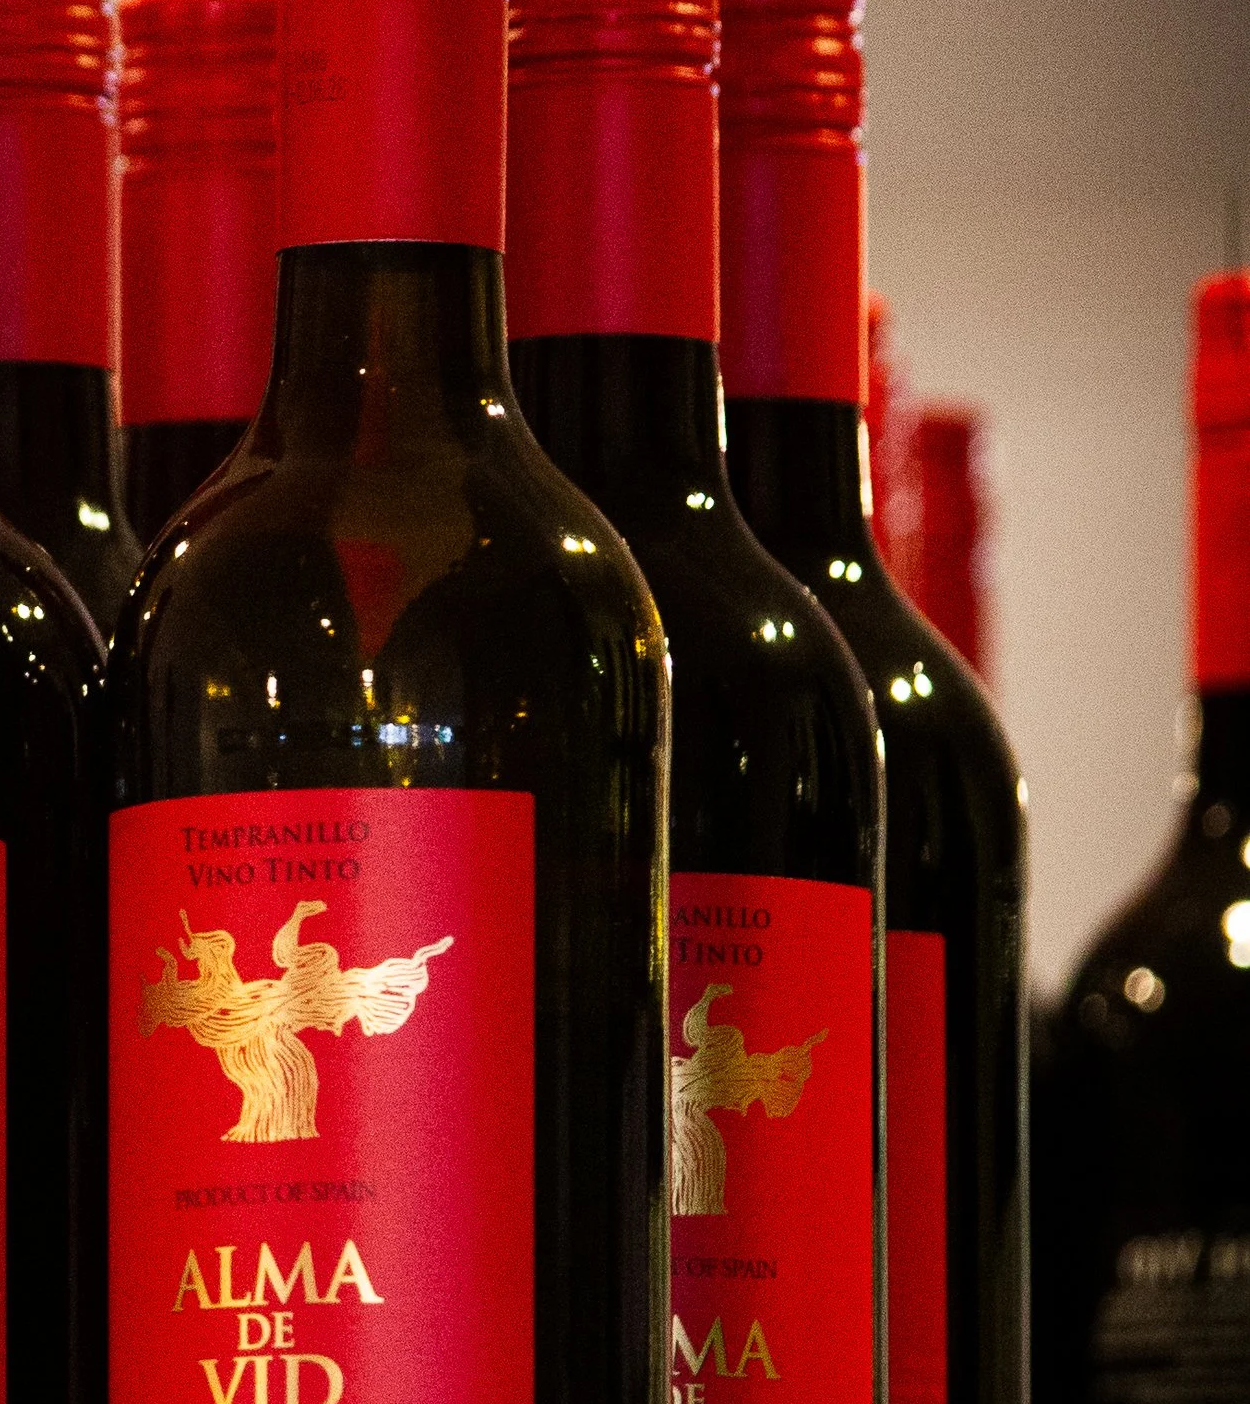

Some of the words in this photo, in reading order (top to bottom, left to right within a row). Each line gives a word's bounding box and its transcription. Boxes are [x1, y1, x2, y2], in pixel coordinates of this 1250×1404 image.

[182, 820, 370, 853] TEMPRANILLO
[188, 861, 254, 889] VINO
[264, 857, 361, 883] TINTO
[672, 904, 771, 929] ANILLO
[676, 936, 763, 966] TINTO
[172, 1238, 385, 1313] ALMA
[236, 1310, 295, 1351] DE
[671, 1313, 781, 1380] MA
